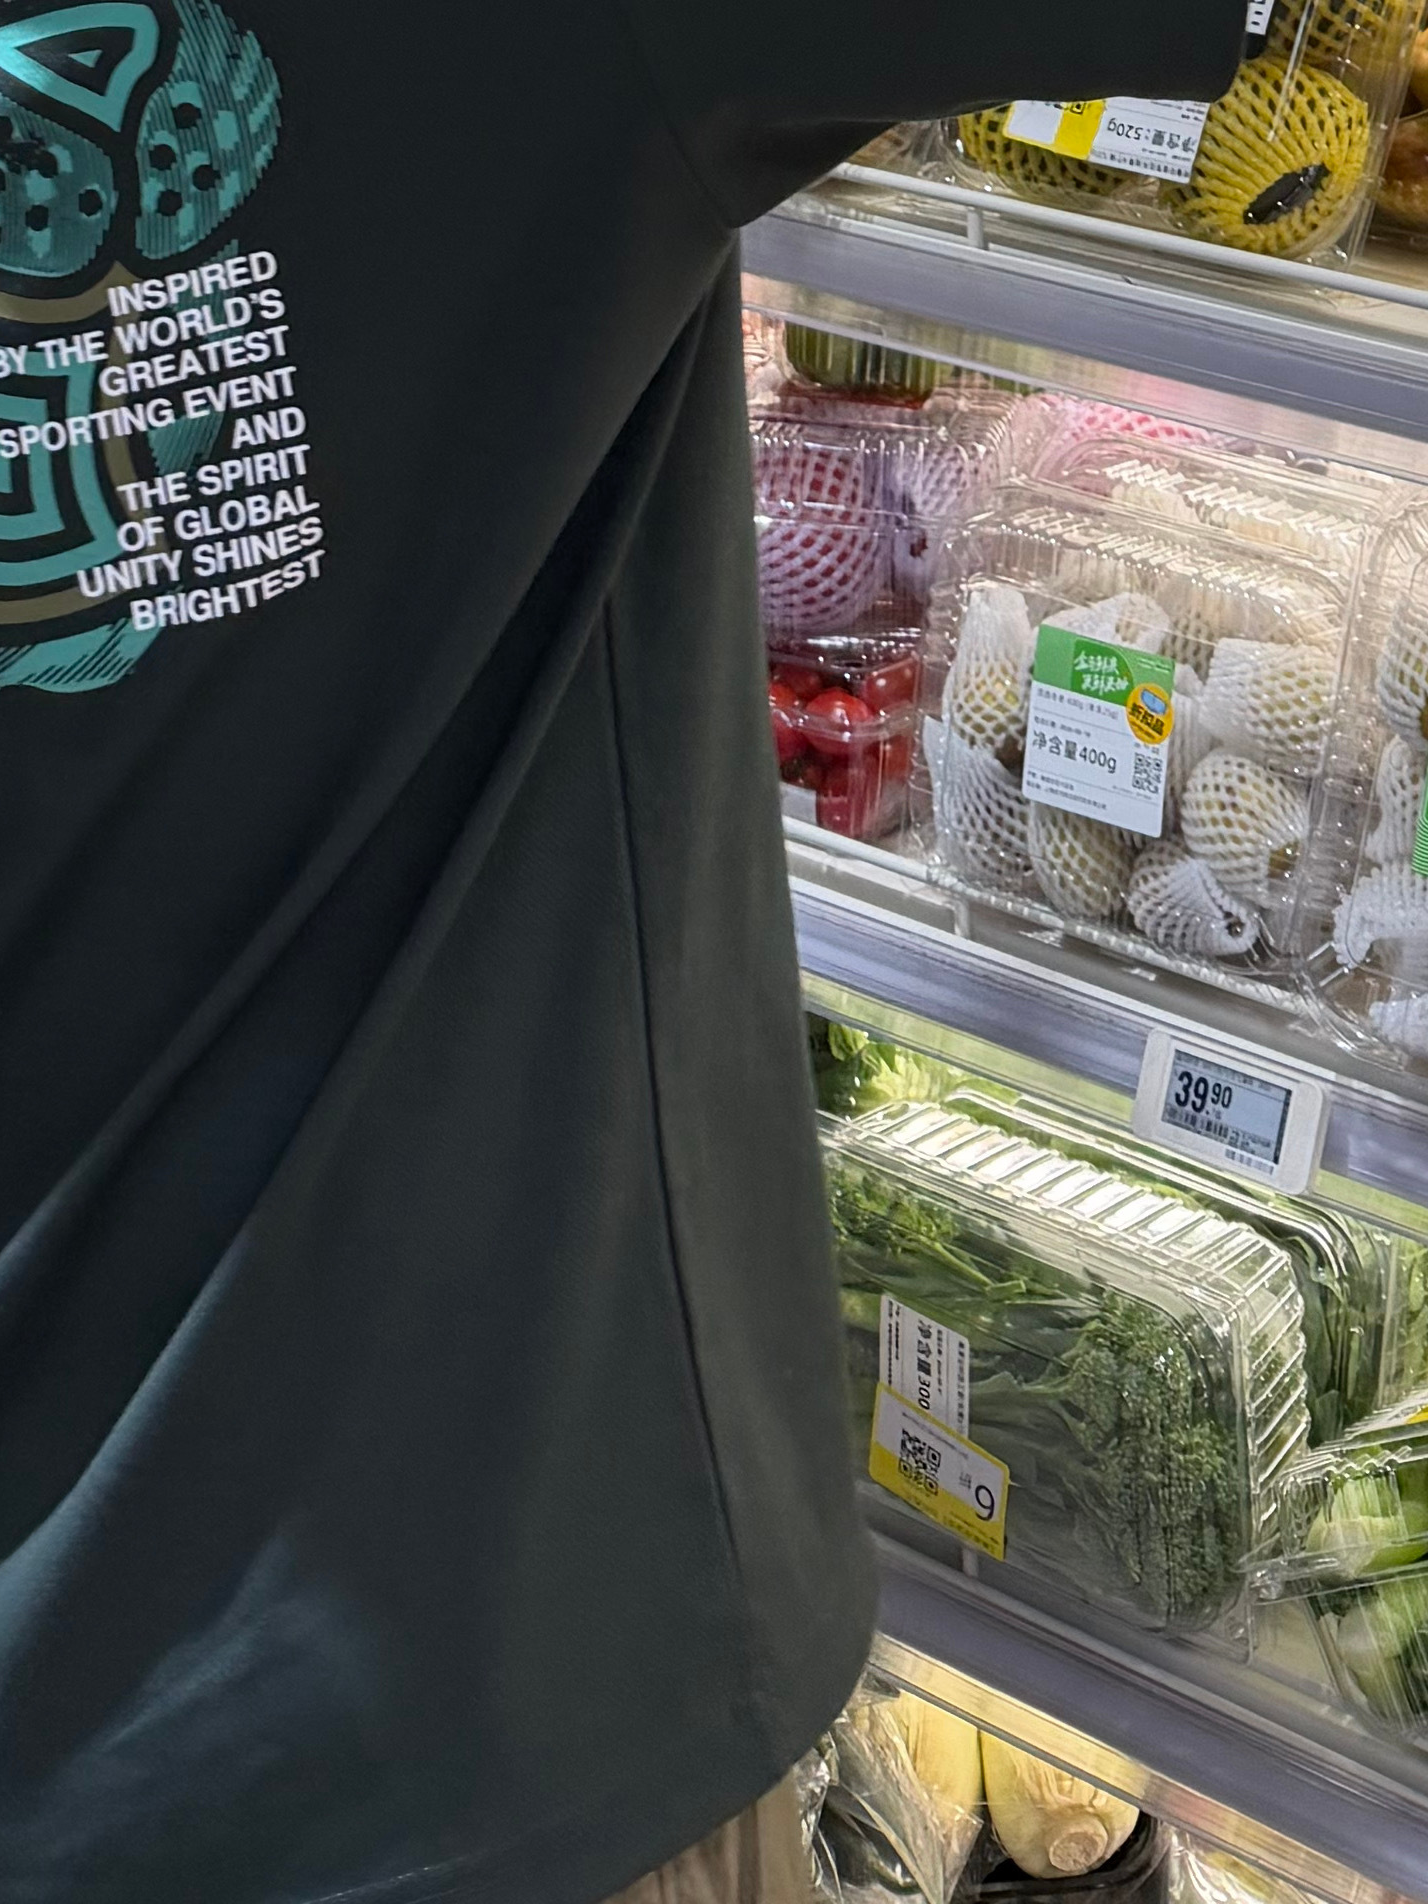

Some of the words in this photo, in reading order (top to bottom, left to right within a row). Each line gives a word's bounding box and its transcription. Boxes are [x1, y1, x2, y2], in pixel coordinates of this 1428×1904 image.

[106, 249, 279, 319] INSPIRED
[34, 331, 106, 375] THE
[116, 288, 287, 355] WORLD'S
[98, 326, 290, 398] GREATEST
[182, 366, 299, 422] EVENT
[230, 406, 308, 452] AND
[117, 477, 190, 516] THE
[196, 445, 312, 501] SPIRIT
[117, 514, 167, 553] OF
[173, 482, 320, 542] GLOBAL
[76, 550, 187, 602] UNITY
[192, 514, 325, 580] SHINES
[130, 551, 325, 633] BRIGHTEST
[1033, 729, 1117, 774] 净含量400g
[916, 1318, 933, 1411] 净含量300
